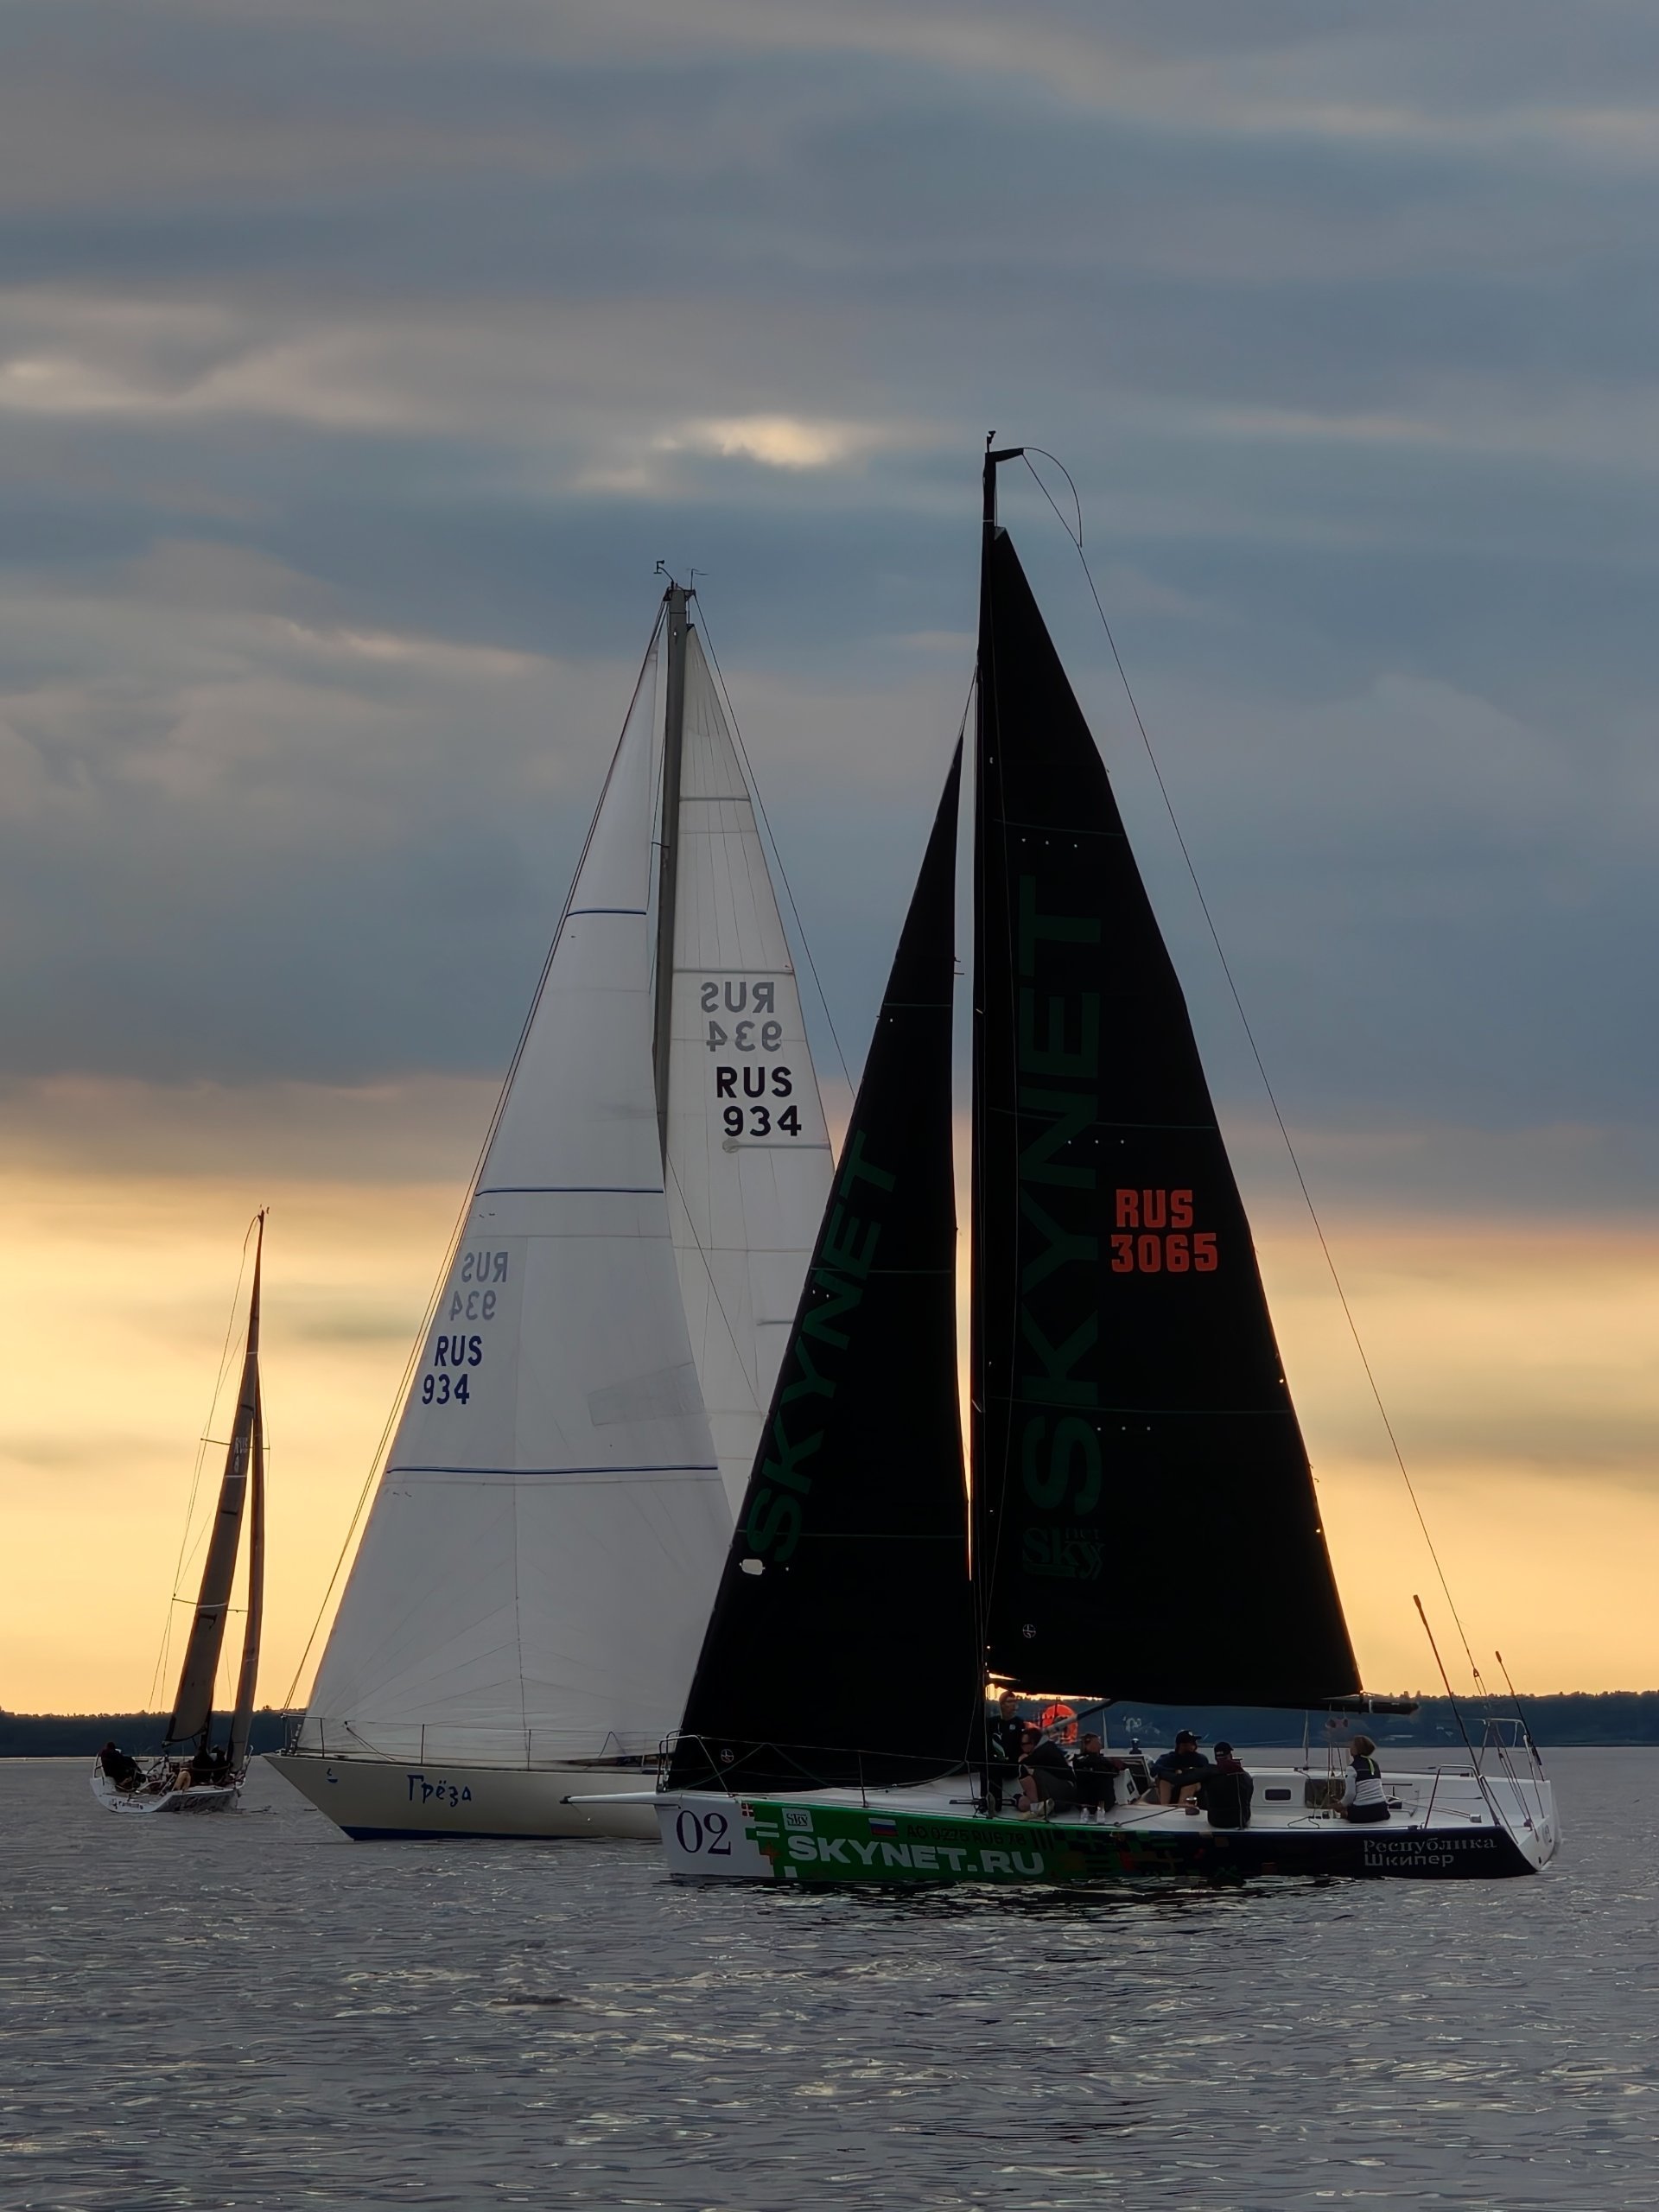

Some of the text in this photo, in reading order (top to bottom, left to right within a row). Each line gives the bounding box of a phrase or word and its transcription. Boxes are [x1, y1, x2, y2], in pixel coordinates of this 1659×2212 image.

[716, 1066, 792, 1097] RUS
[723, 1105, 802, 1136] 934
[1018, 874, 1103, 1516] SKYNET
[1116, 1189, 1193, 1228] RUS
[1111, 1233, 1218, 1272] 3065
[434, 1335, 482, 1366] RUS
[745, 1130, 896, 1562] SKYNET
[422, 1374, 470, 1404] 934
[407, 1775, 472, 1807] Грёза
[677, 1810, 731, 1855] 02
[971, 1829, 1003, 1846] RUS
[1363, 1837, 1497, 1853] Республика
[788, 1835, 1045, 1875] SKYNET.RU
[1364, 1853, 1455, 1868] Шкипер
